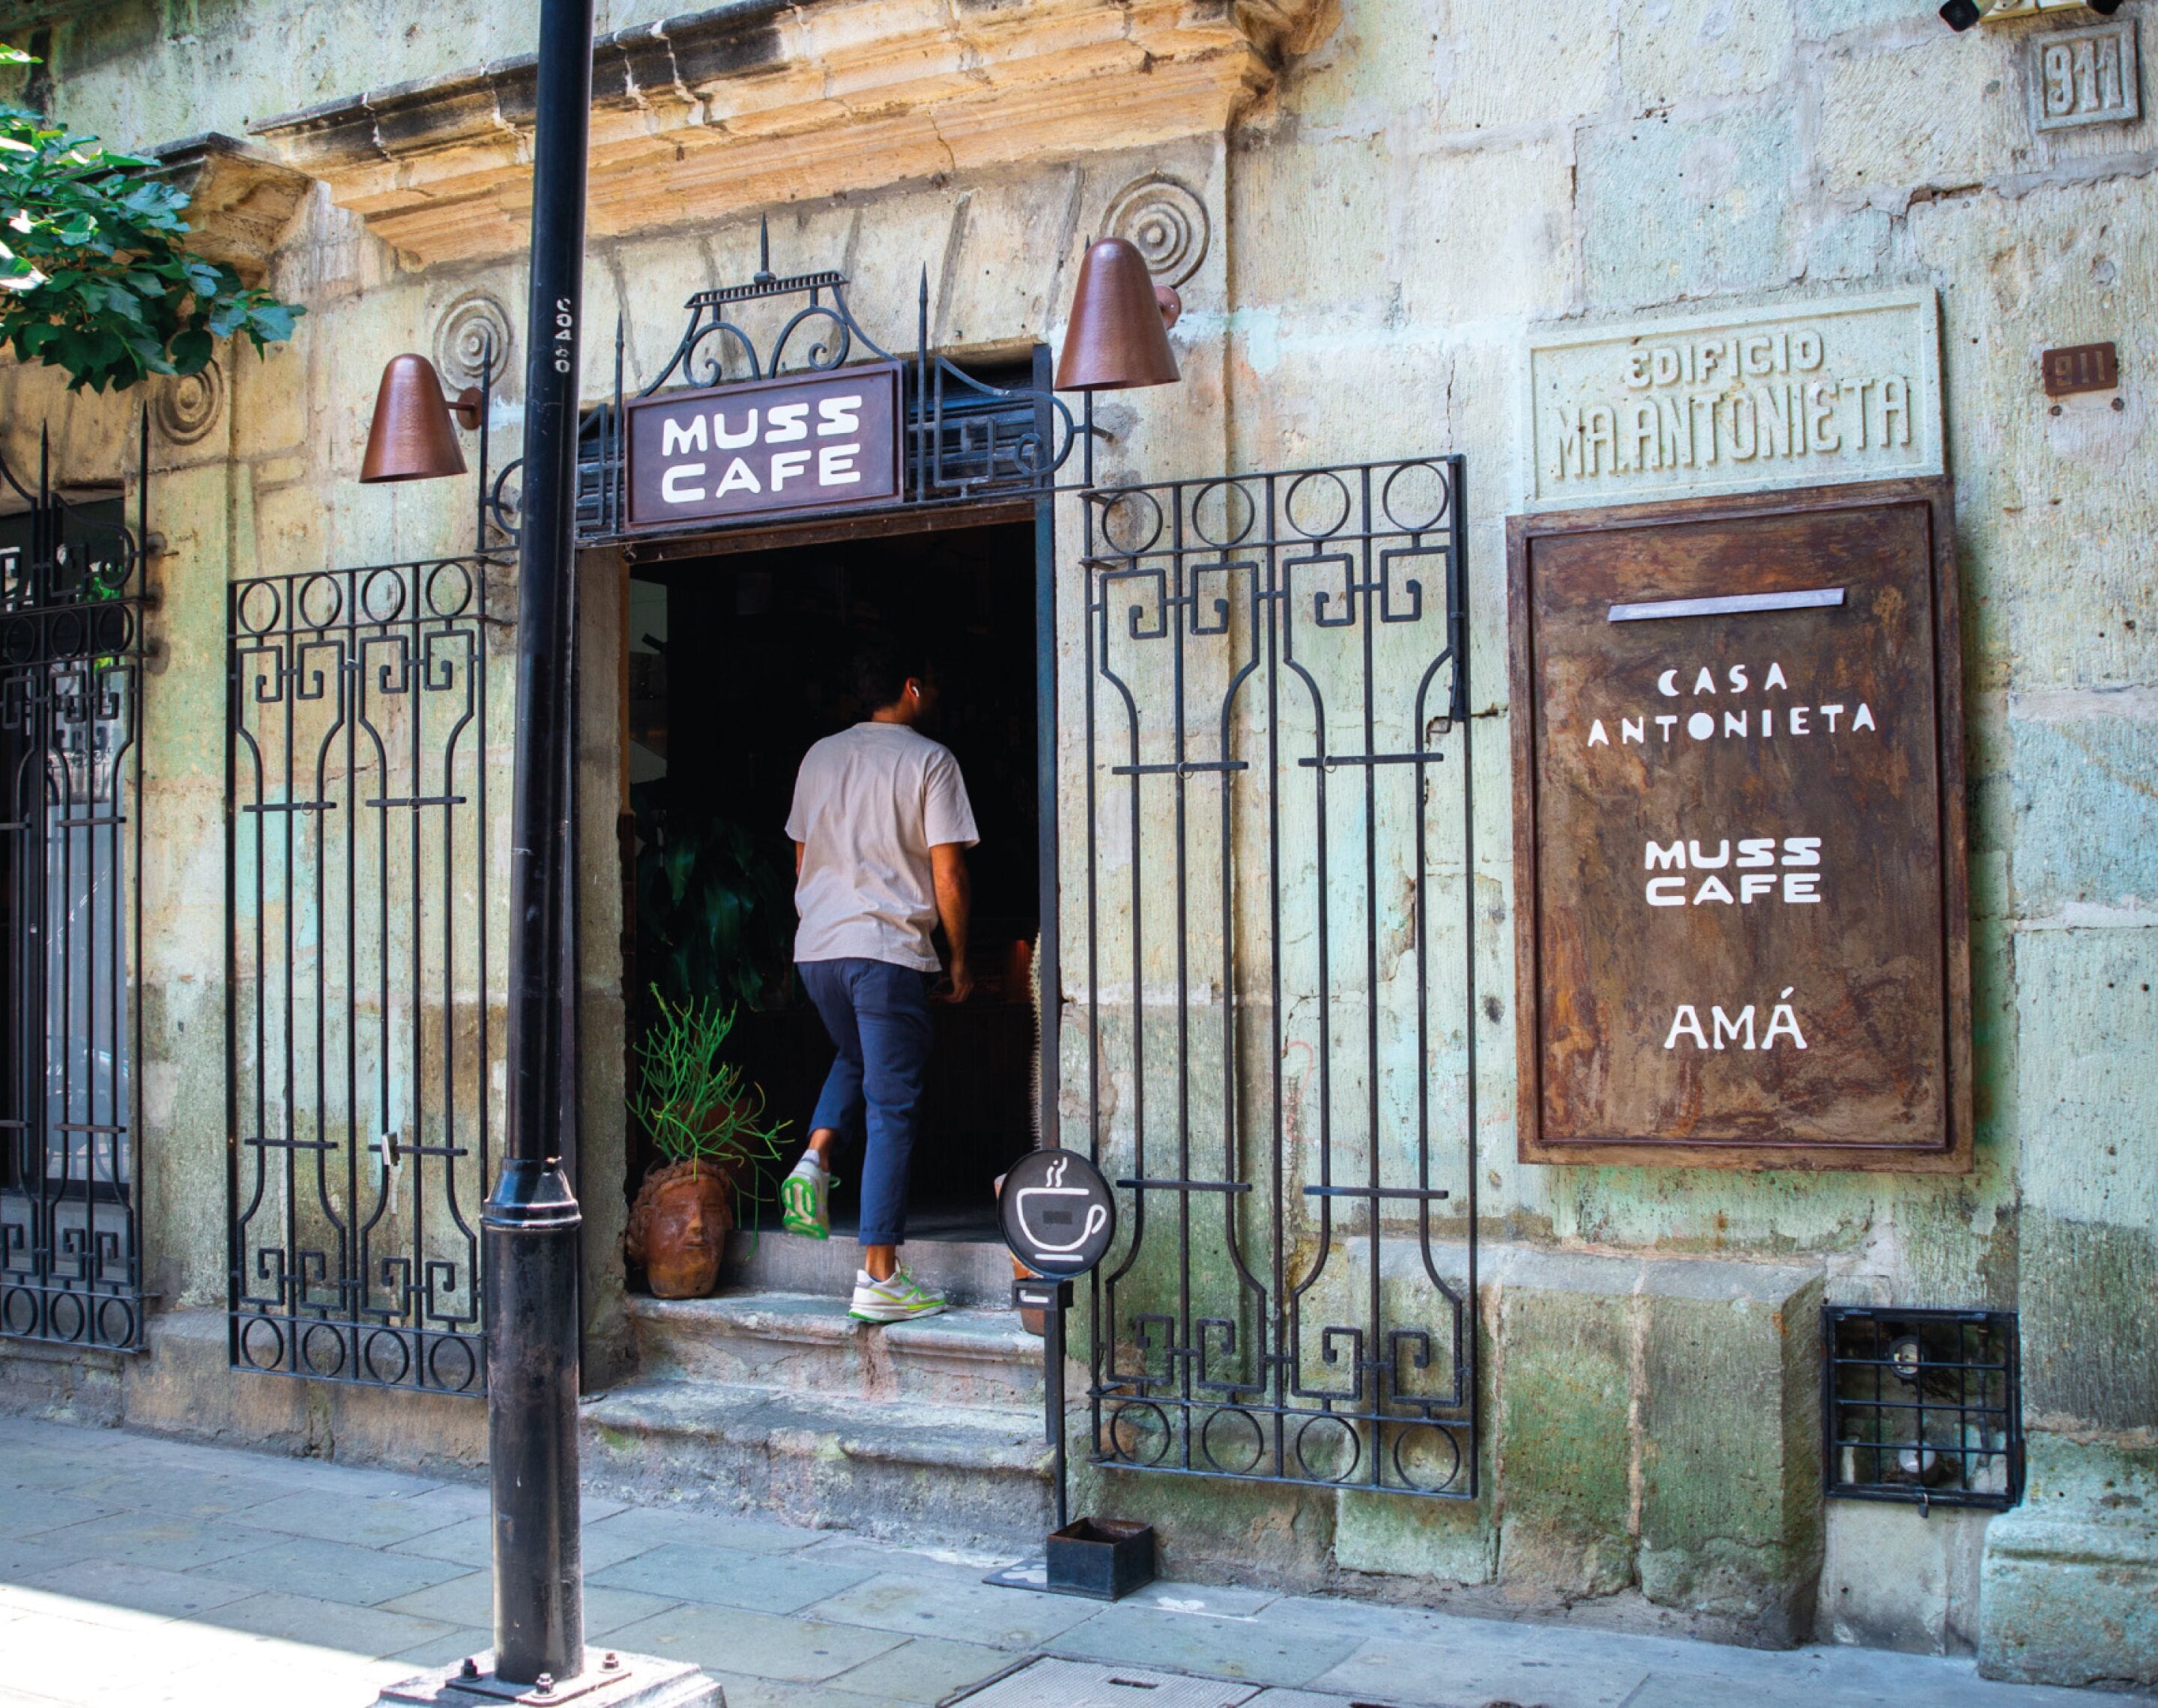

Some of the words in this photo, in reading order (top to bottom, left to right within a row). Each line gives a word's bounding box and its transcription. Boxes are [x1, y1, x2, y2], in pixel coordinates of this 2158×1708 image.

[2046, 36, 2123, 115] 911
[1624, 328, 1825, 390] EDIFICIO
[2055, 351, 2106, 387] 911
[662, 395, 862, 457] MUSS
[662, 442, 861, 504] CAFE
[1657, 662, 1787, 697] CASA
[1587, 703, 1876, 748] ANTONIETA
[1644, 837, 1822, 870] MUSS
[1645, 873, 1822, 906] CAFE
[1663, 987, 1807, 1050] AMÁ
